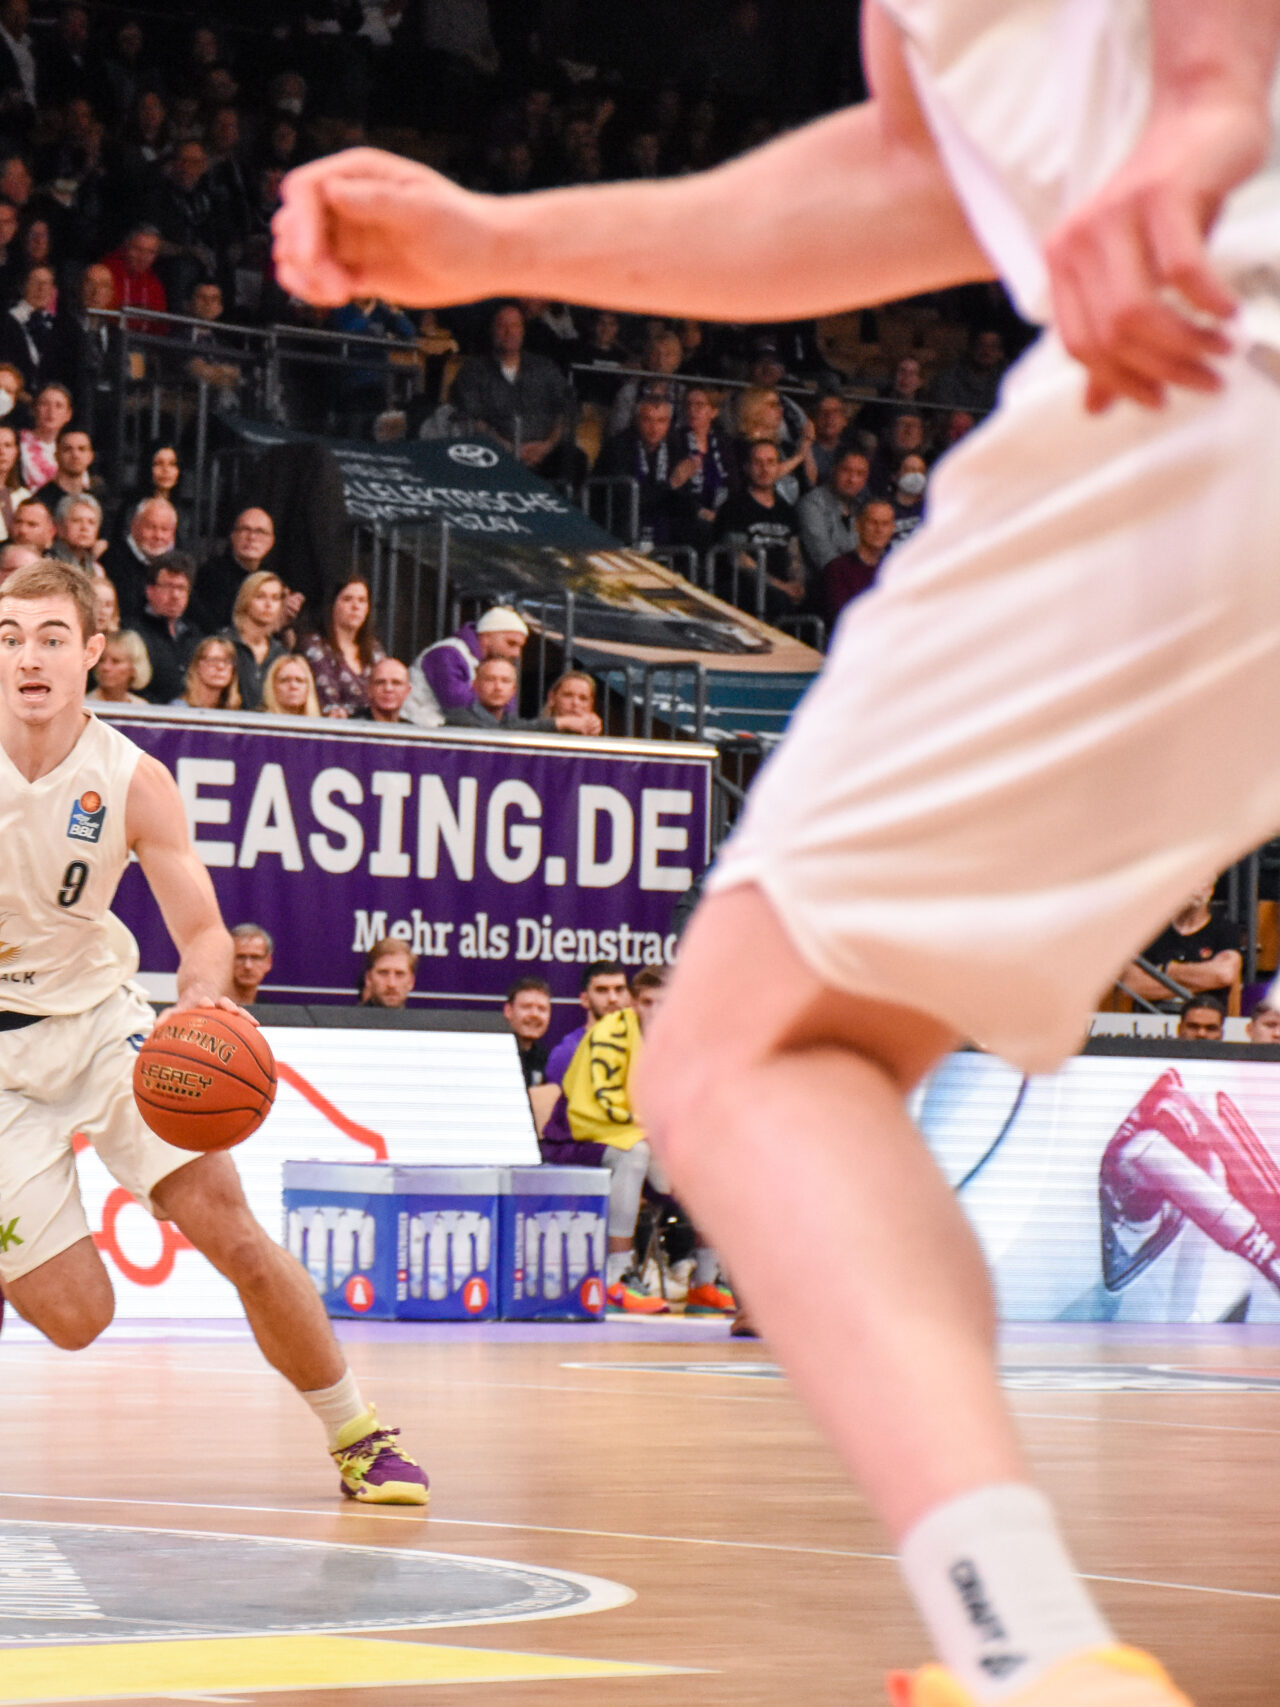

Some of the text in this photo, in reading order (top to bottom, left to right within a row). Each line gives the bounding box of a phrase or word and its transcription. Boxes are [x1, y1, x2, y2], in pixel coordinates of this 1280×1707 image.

[69, 823, 97, 840] BBL
[175, 757, 693, 892] EASING.DE
[57, 860, 90, 909] 9
[352, 908, 454, 957] Mehr
[459, 912, 510, 960] als
[140, 1060, 213, 1090] LEGACY
